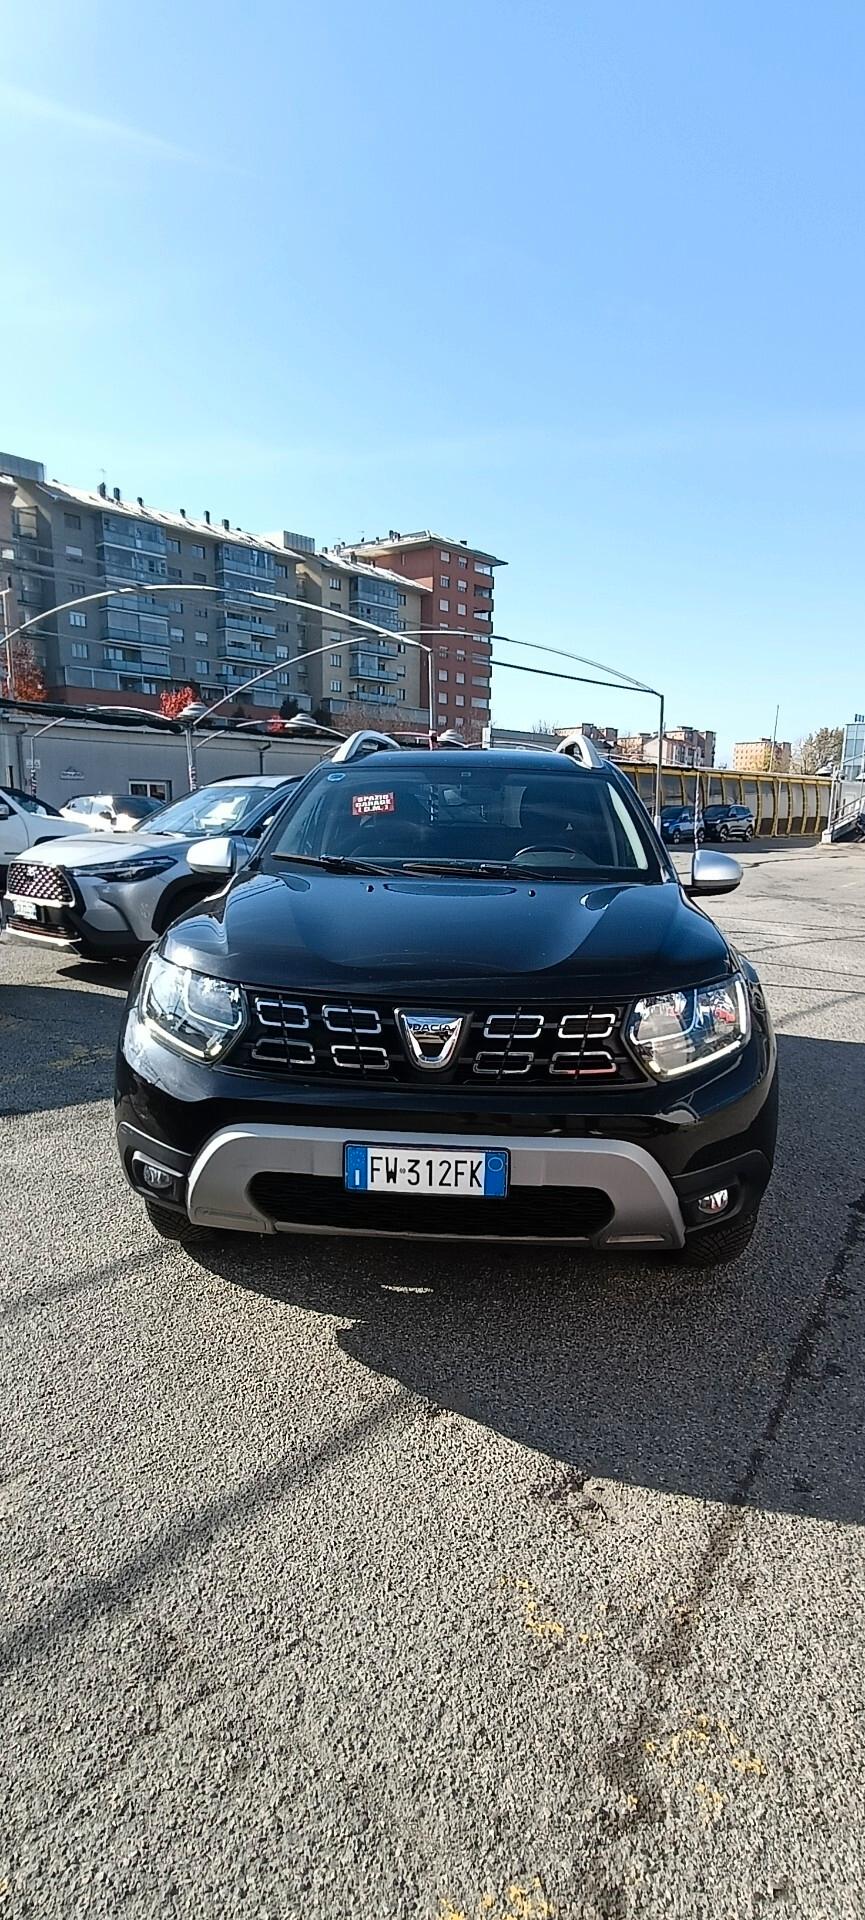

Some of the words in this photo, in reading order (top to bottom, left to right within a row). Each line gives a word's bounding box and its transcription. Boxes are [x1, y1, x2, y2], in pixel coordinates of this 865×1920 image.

[357, 794, 389, 803] SPAZIO
[355, 799, 391, 808] GARAGE
[412, 1023, 451, 1031] DACIA
